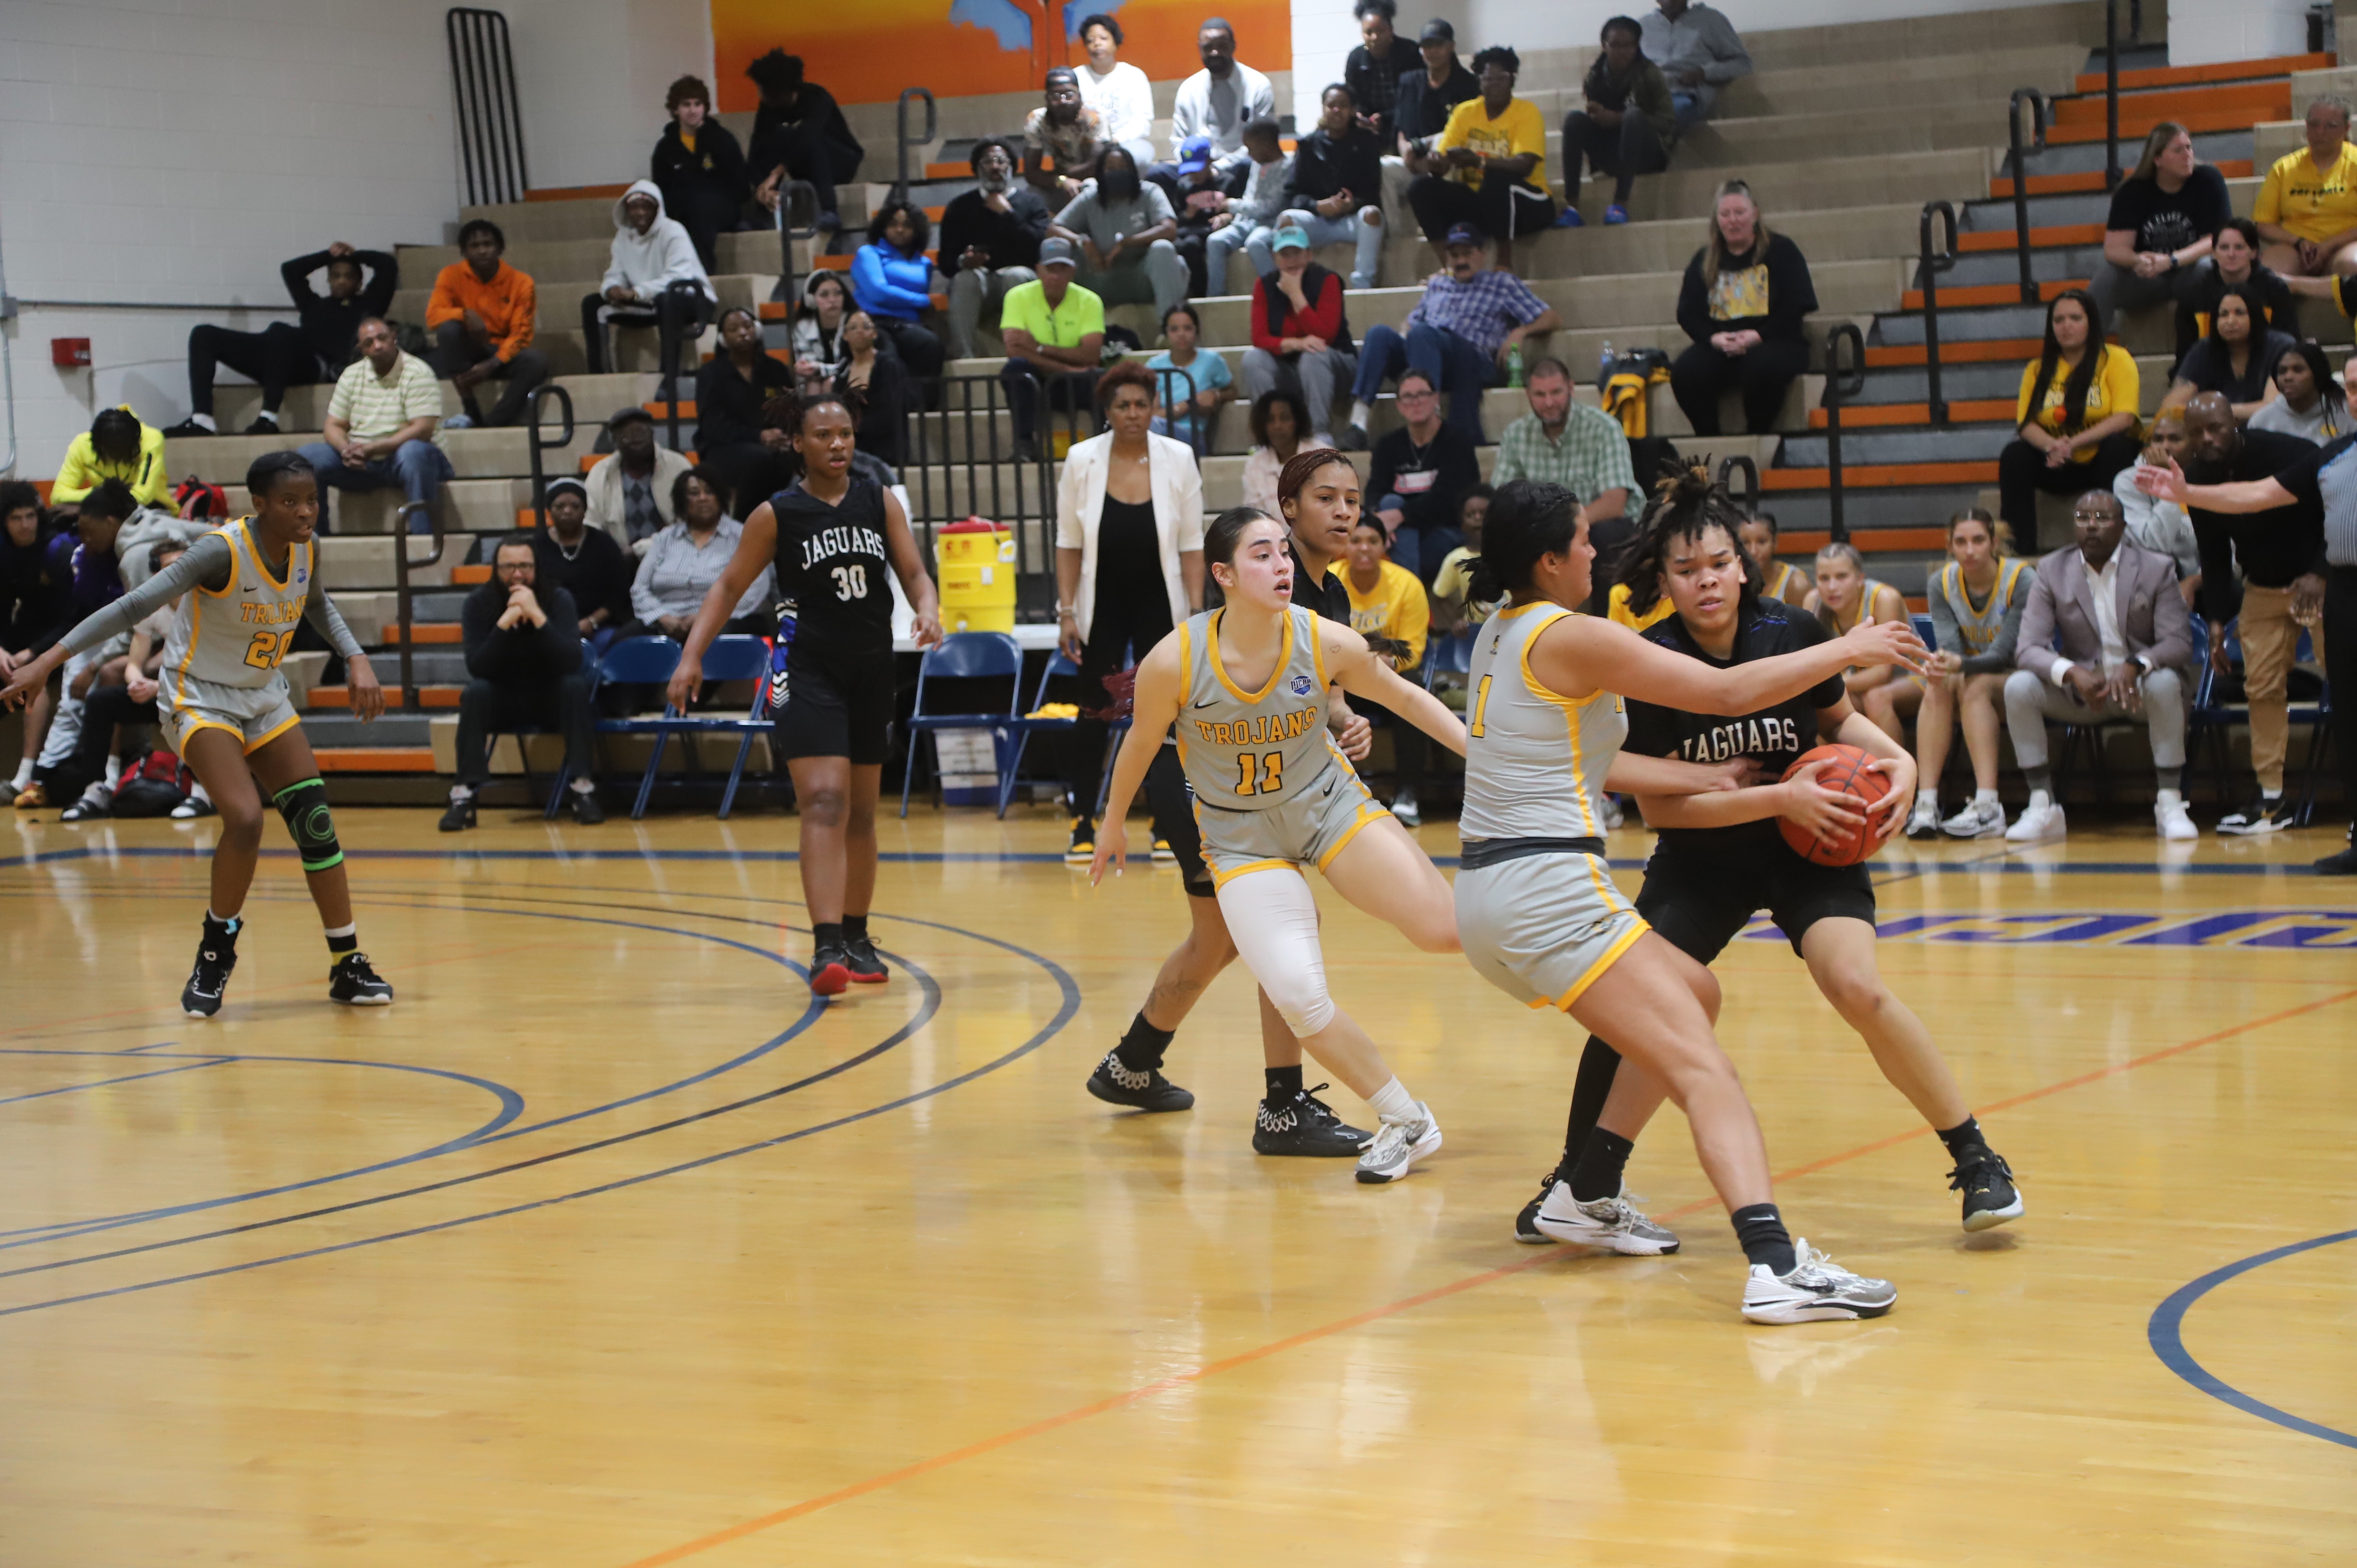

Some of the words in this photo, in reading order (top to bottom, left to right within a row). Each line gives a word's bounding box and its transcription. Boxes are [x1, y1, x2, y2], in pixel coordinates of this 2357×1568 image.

[802, 526, 886, 570] JAGUARS
[831, 564, 868, 602] 30
[1194, 706, 1317, 745] TROJANS
[1471, 674, 1493, 739] 1
[1235, 751, 1283, 796] 11
